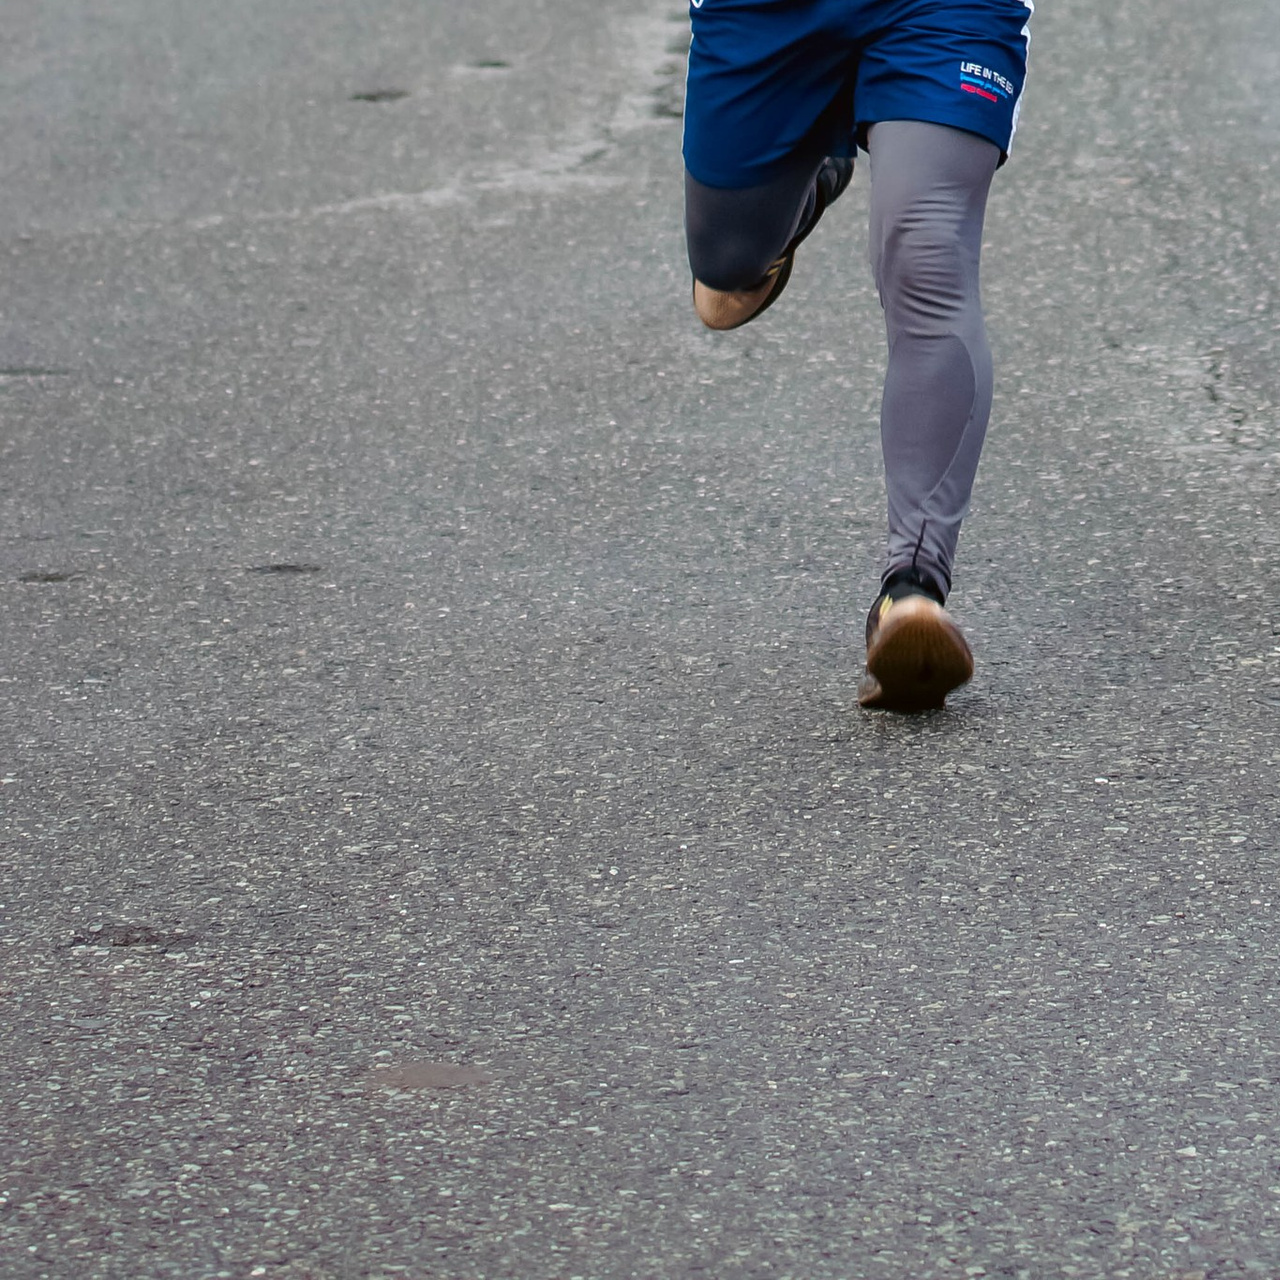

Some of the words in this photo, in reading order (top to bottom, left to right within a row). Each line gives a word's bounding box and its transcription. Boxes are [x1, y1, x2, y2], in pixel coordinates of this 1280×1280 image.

[960, 61, 982, 76] LIFE
[982, 67, 992, 79] IN
[993, 71, 1007, 88] THE
